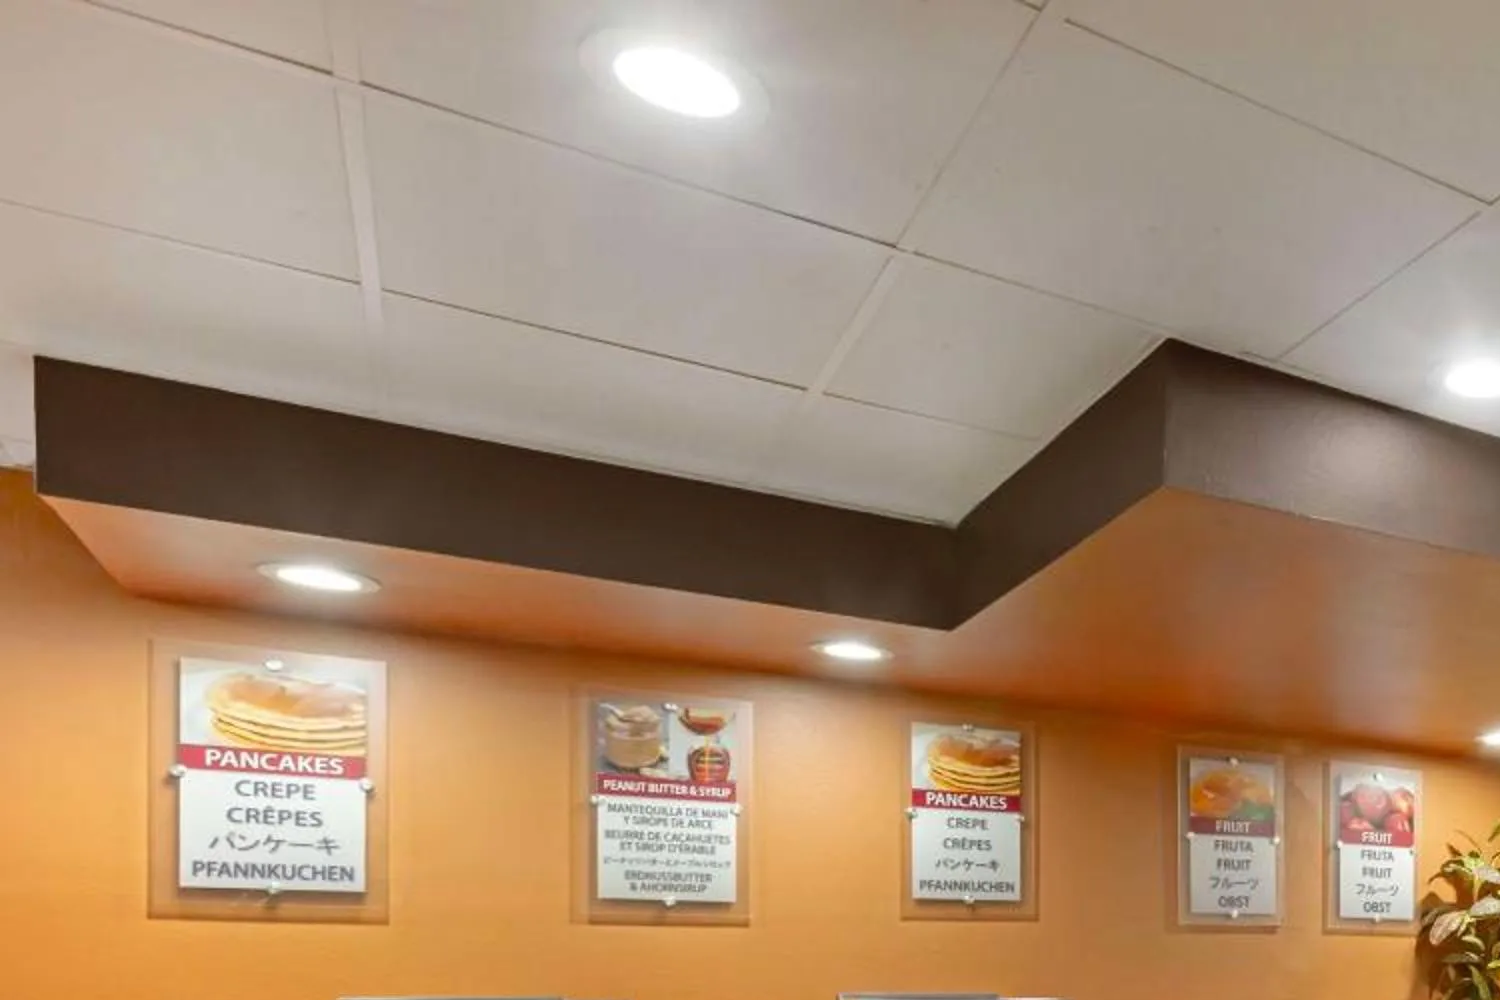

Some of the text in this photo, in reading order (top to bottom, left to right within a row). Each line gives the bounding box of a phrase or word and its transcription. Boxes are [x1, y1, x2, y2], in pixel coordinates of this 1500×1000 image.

[204, 749, 343, 775] PANCAKES
[234, 780, 316, 801] CREPE
[604, 779, 646, 792] PEANUT
[648, 782, 689, 795] BUTTER
[700, 786, 732, 797] SYRUP
[926, 792, 1007, 810] PANCAKES
[226, 806, 323, 827] CRÊPES
[947, 817, 988, 830] CREPE
[1216, 820, 1251, 833] FRUIT
[1361, 832, 1392, 844] FRUIT
[1214, 839, 1253, 852] FRUTA
[1361, 849, 1394, 862] FRUTA
[1217, 858, 1251, 871] FRUIT
[192, 860, 355, 883] PFANNKUCHEN
[1362, 867, 1392, 878] FRUIT
[919, 879, 1015, 893] PFANNKUCHEN
[1218, 896, 1249, 909] OBST
[1364, 901, 1392, 913] OBST
